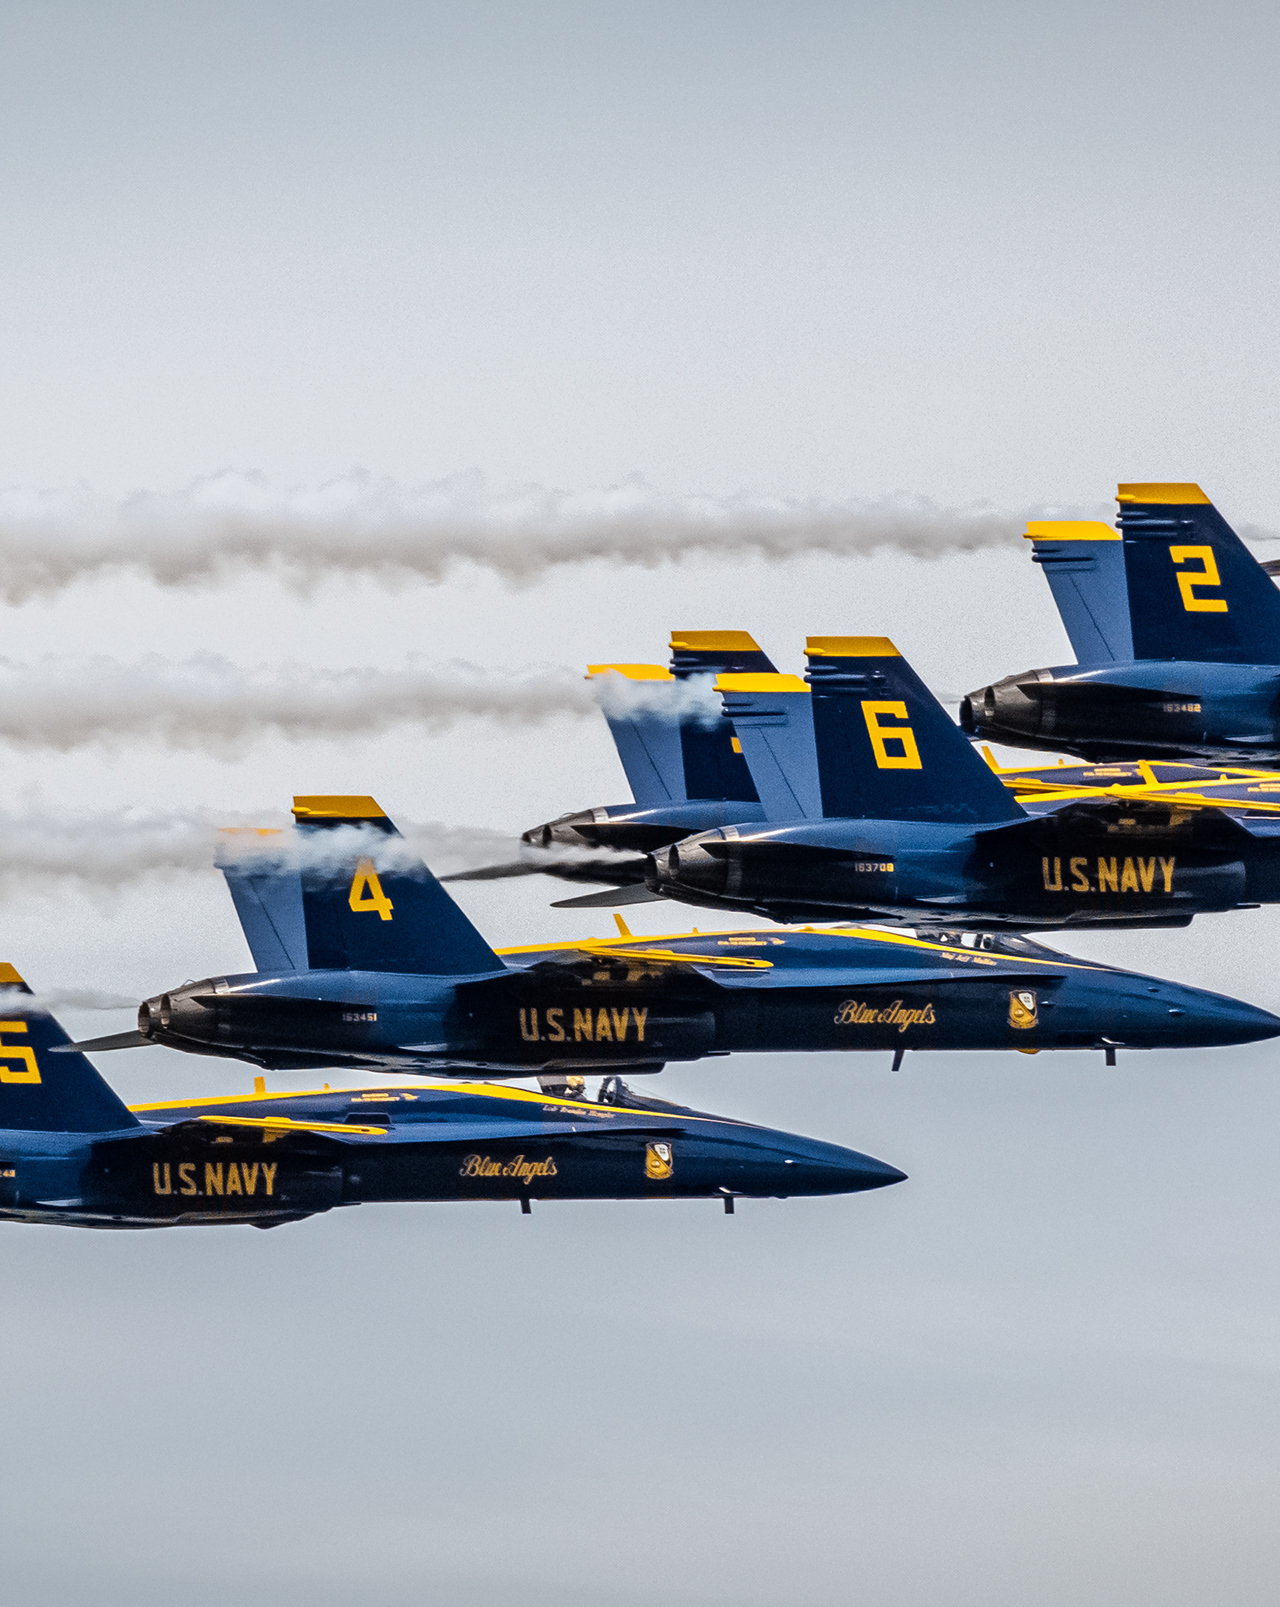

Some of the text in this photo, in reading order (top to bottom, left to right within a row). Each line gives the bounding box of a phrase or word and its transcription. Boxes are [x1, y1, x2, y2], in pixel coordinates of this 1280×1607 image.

[1169, 545, 1228, 612] 2
[861, 700, 922, 769] 6
[348, 858, 393, 921] 4
[834, 1000, 936, 1033] Blue Angels
[459, 1154, 558, 1185] Blue Angels
